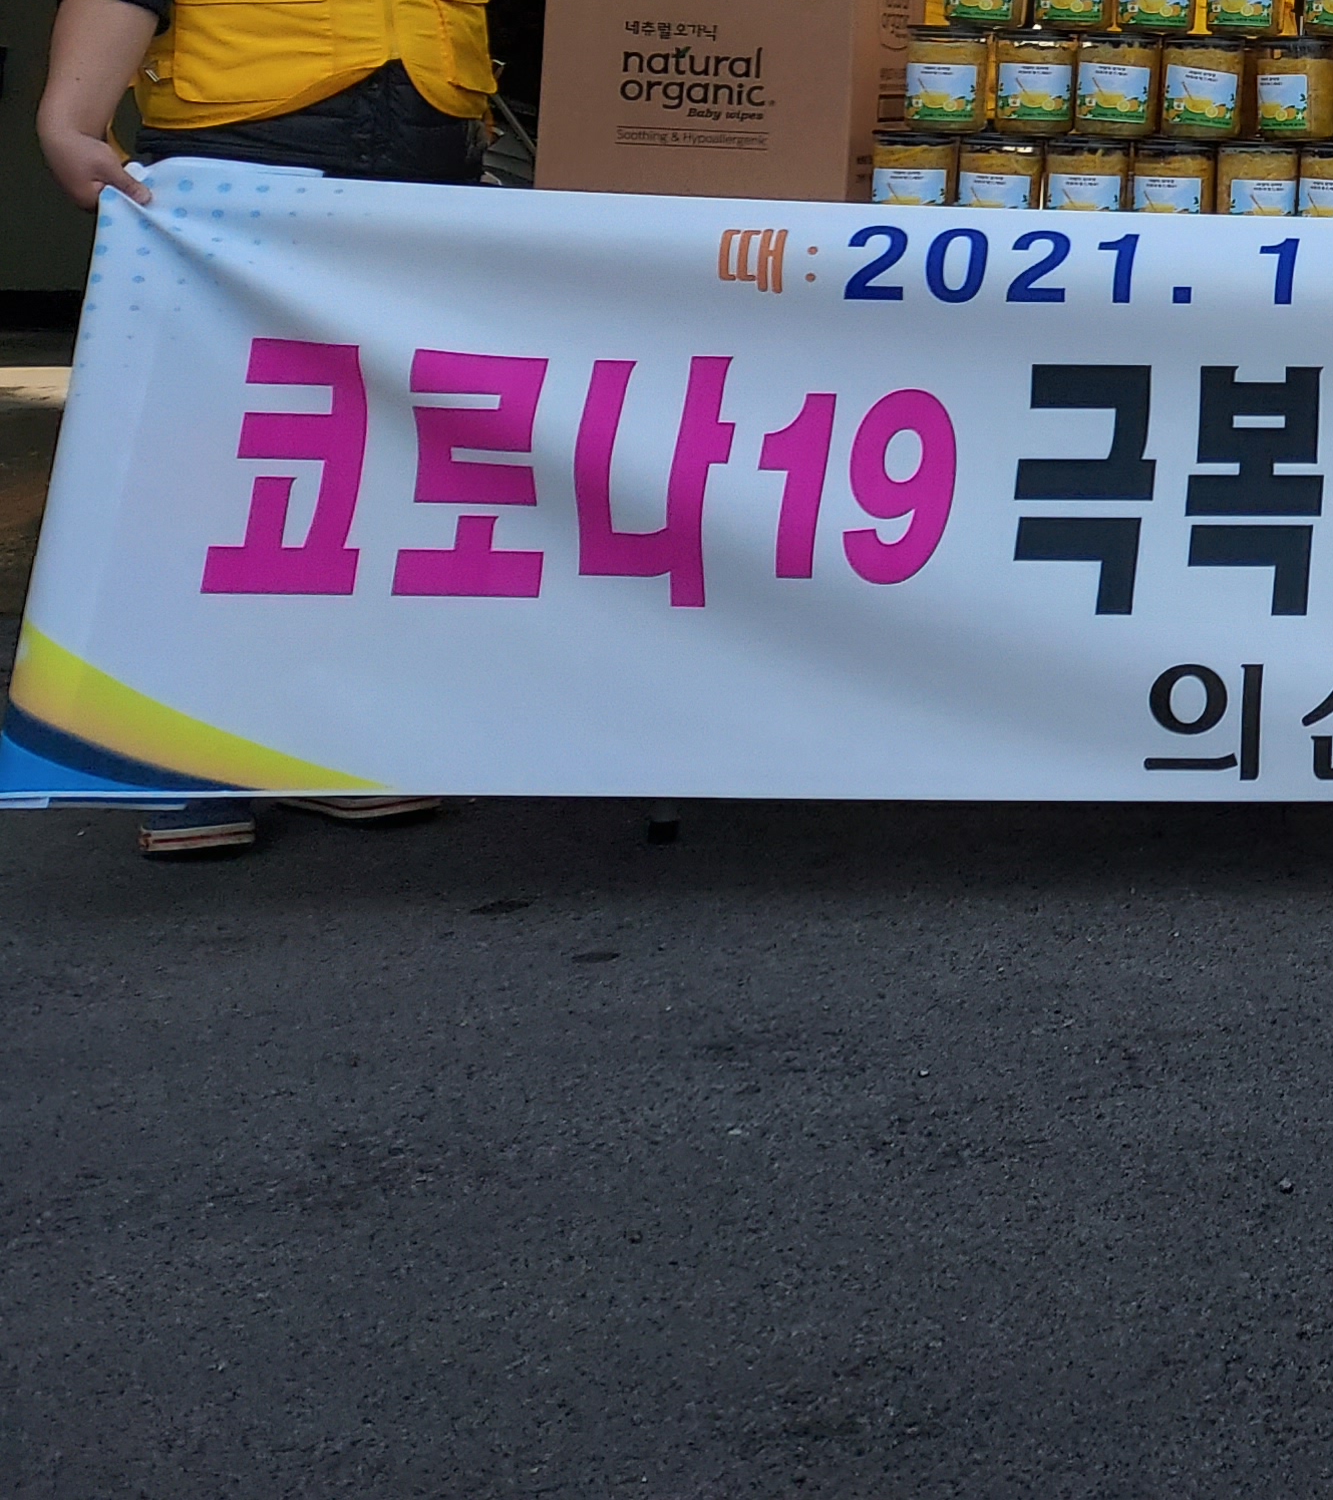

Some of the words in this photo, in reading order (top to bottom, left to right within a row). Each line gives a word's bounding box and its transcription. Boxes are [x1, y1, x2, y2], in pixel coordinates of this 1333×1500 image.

[622, 46, 763, 79] natural
[620, 79, 766, 110] organic
[687, 108, 722, 121] Baby
[726, 112, 763, 122] wipes
[617, 129, 667, 142] Soothing
[671, 132, 679, 141] &
[843, 224, 1193, 306] 2021.
[199, 336, 960, 610] 코로나19
